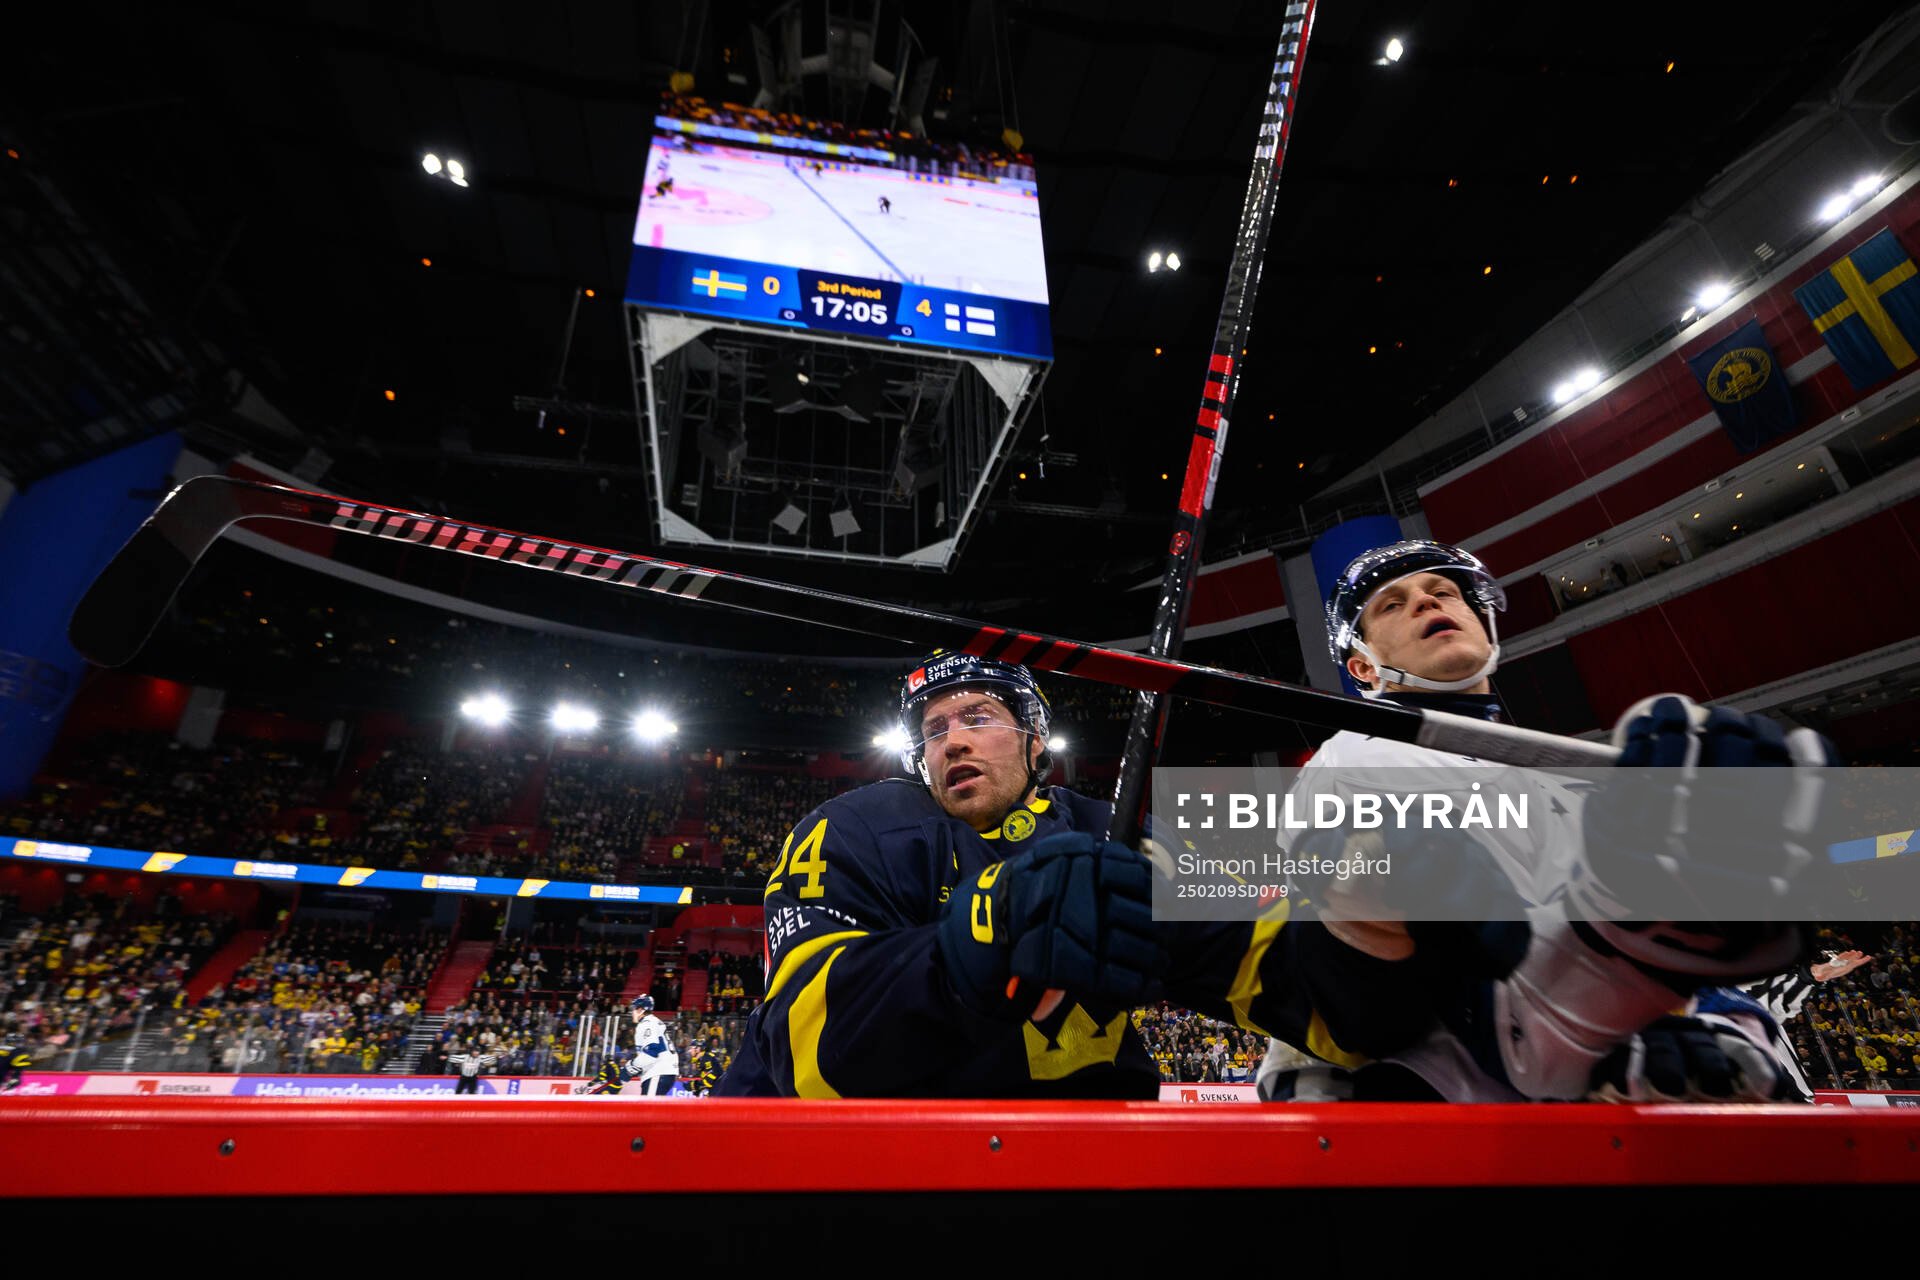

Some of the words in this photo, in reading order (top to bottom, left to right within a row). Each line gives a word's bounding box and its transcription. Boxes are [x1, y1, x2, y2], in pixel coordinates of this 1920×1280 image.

[763, 276, 781, 295] 0
[817, 280, 839, 296] 3rd
[841, 284, 882, 300] Period
[811, 296, 888, 325] 17:05
[916, 299, 933, 317] 4
[330, 502, 715, 600] WARRIOR
[927, 656, 978, 675] SVENSKA
[928, 668, 954, 683] SPEL
[764, 818, 828, 901] 24
[771, 913, 811, 958] SPEL
[1200, 1093, 1240, 1102] SVENSKA
